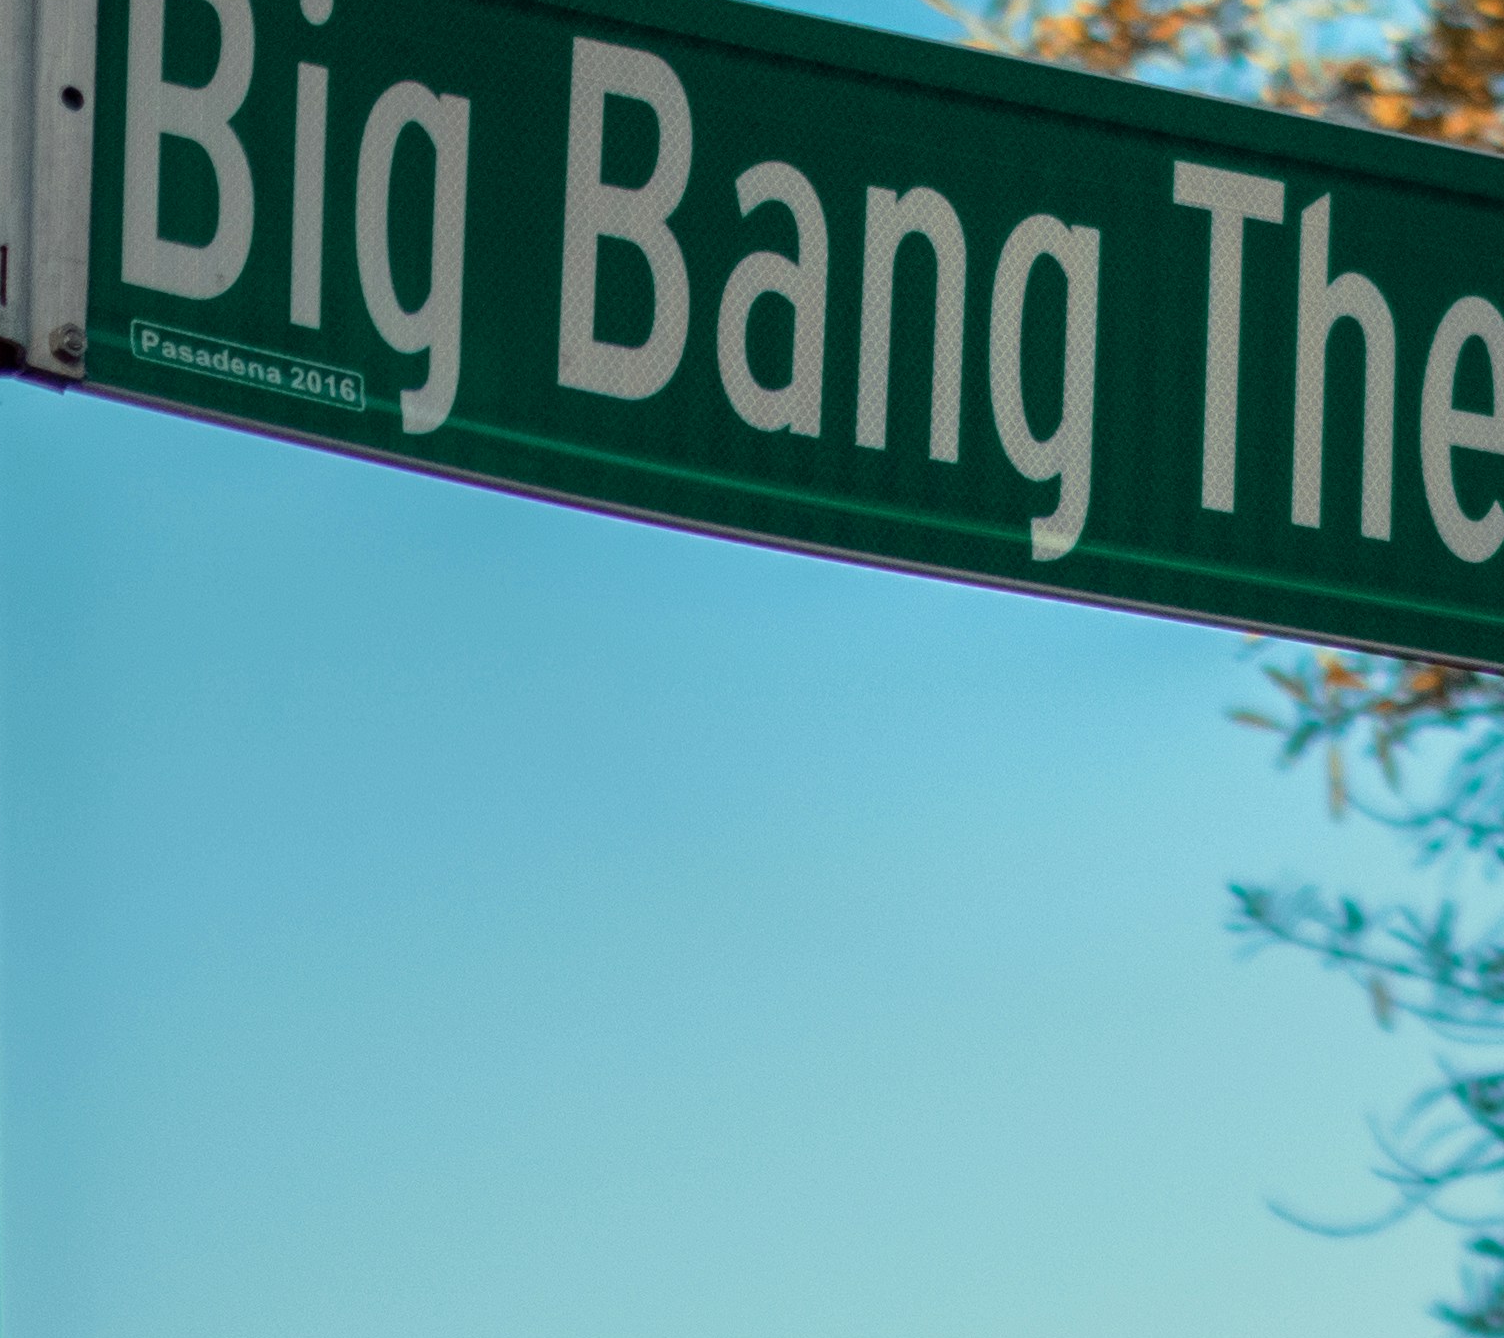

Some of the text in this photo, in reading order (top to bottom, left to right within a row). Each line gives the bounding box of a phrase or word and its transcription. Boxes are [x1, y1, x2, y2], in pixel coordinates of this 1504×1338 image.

[141, 329, 356, 402] Pasadena 2016
[557, 37, 1101, 561] Bang
